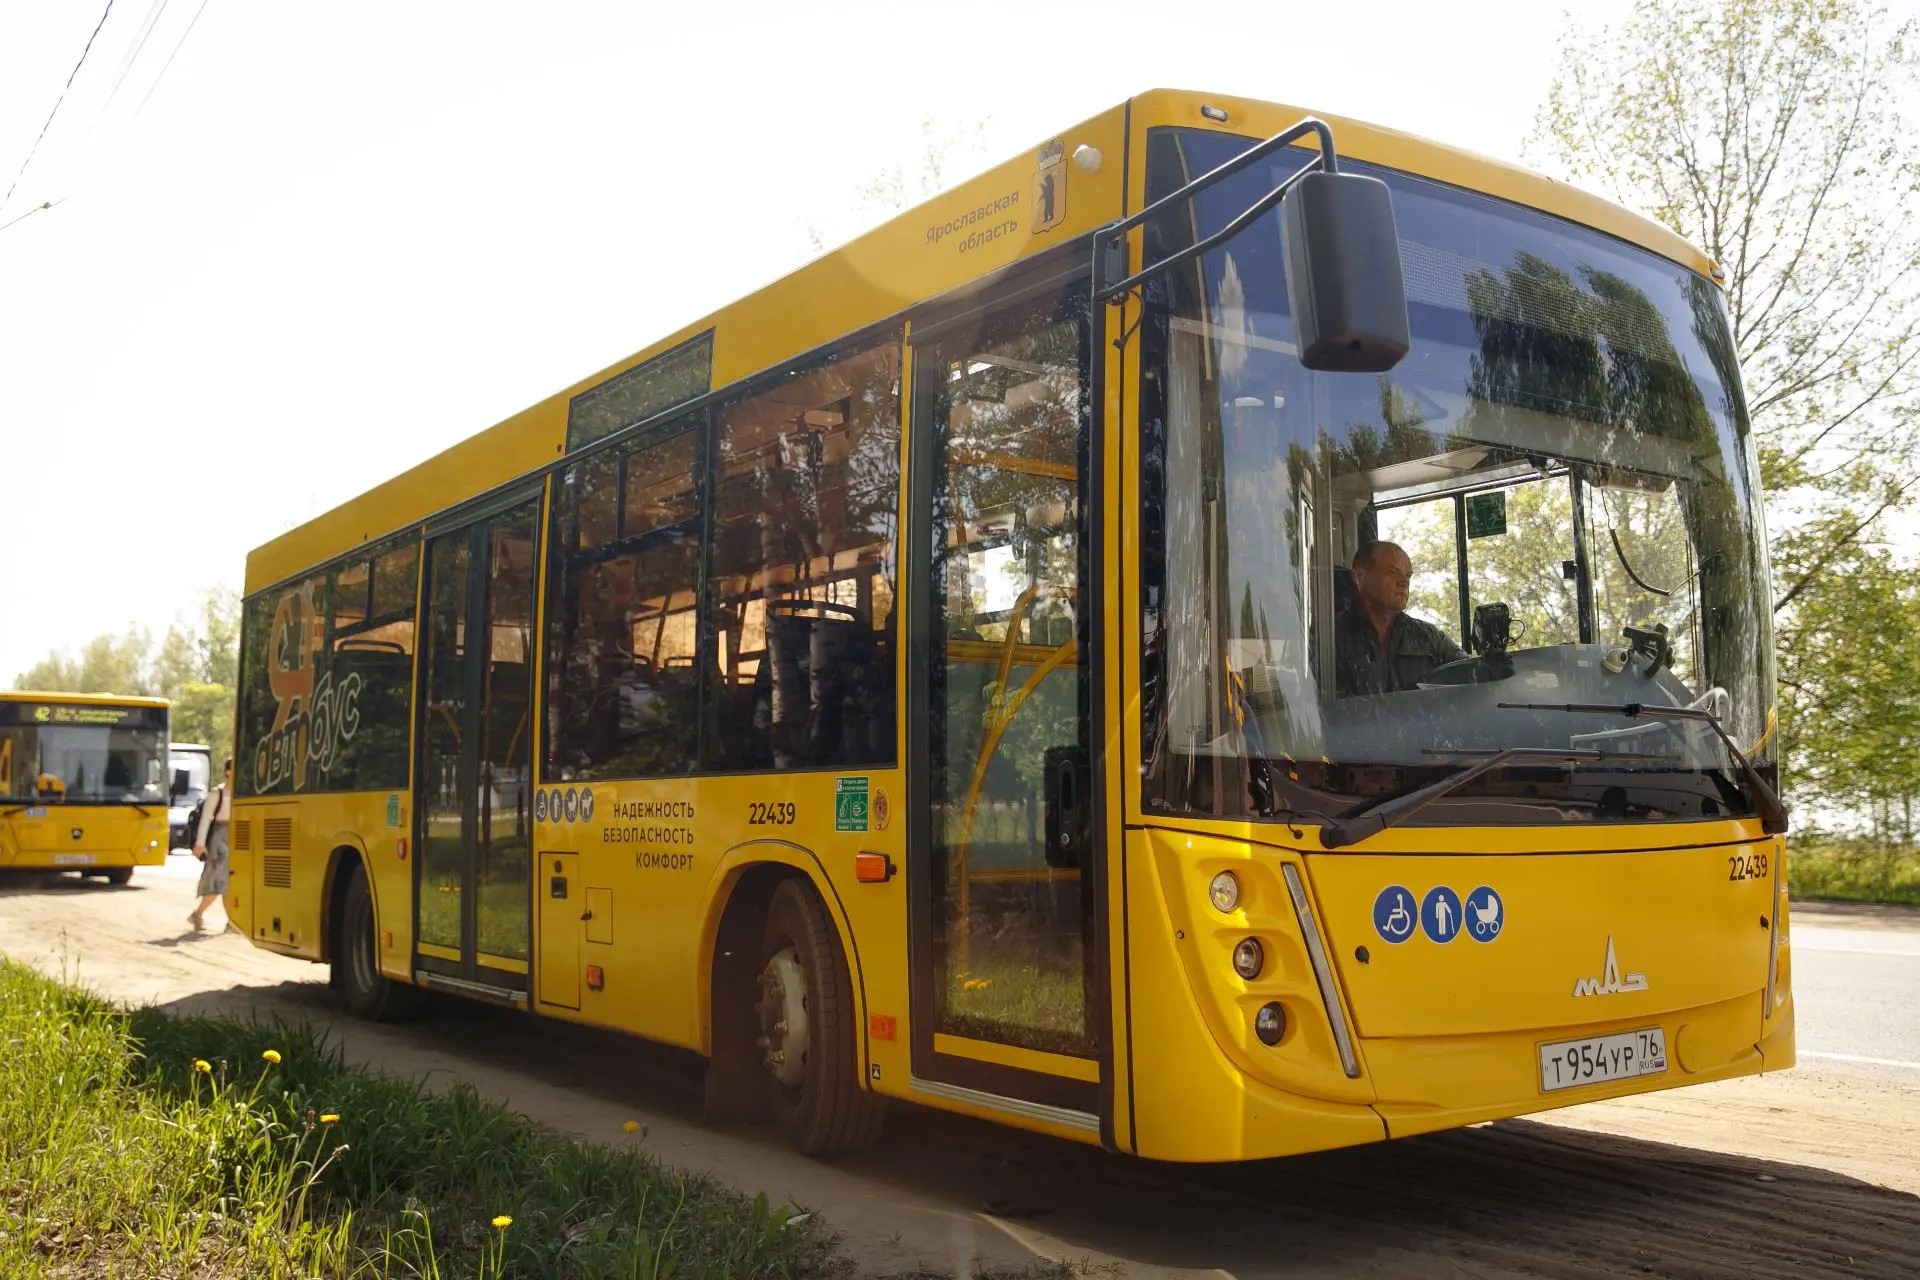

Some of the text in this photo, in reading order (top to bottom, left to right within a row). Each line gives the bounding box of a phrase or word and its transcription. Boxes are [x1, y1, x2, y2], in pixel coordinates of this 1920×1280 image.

[926, 191, 1019, 244] Ярославская
[958, 218, 1018, 254] область
[613, 802, 695, 820] НАДЕЖНОСТЬ
[749, 802, 796, 825] 22439
[603, 827, 694, 845] БЕЗОПАСНОСТЬ
[635, 852, 694, 870] КОМФОРТ
[1728, 854, 1768, 881] 22439
[1639, 1033, 1659, 1058] 76
[1640, 1060, 1655, 1070] RUS
